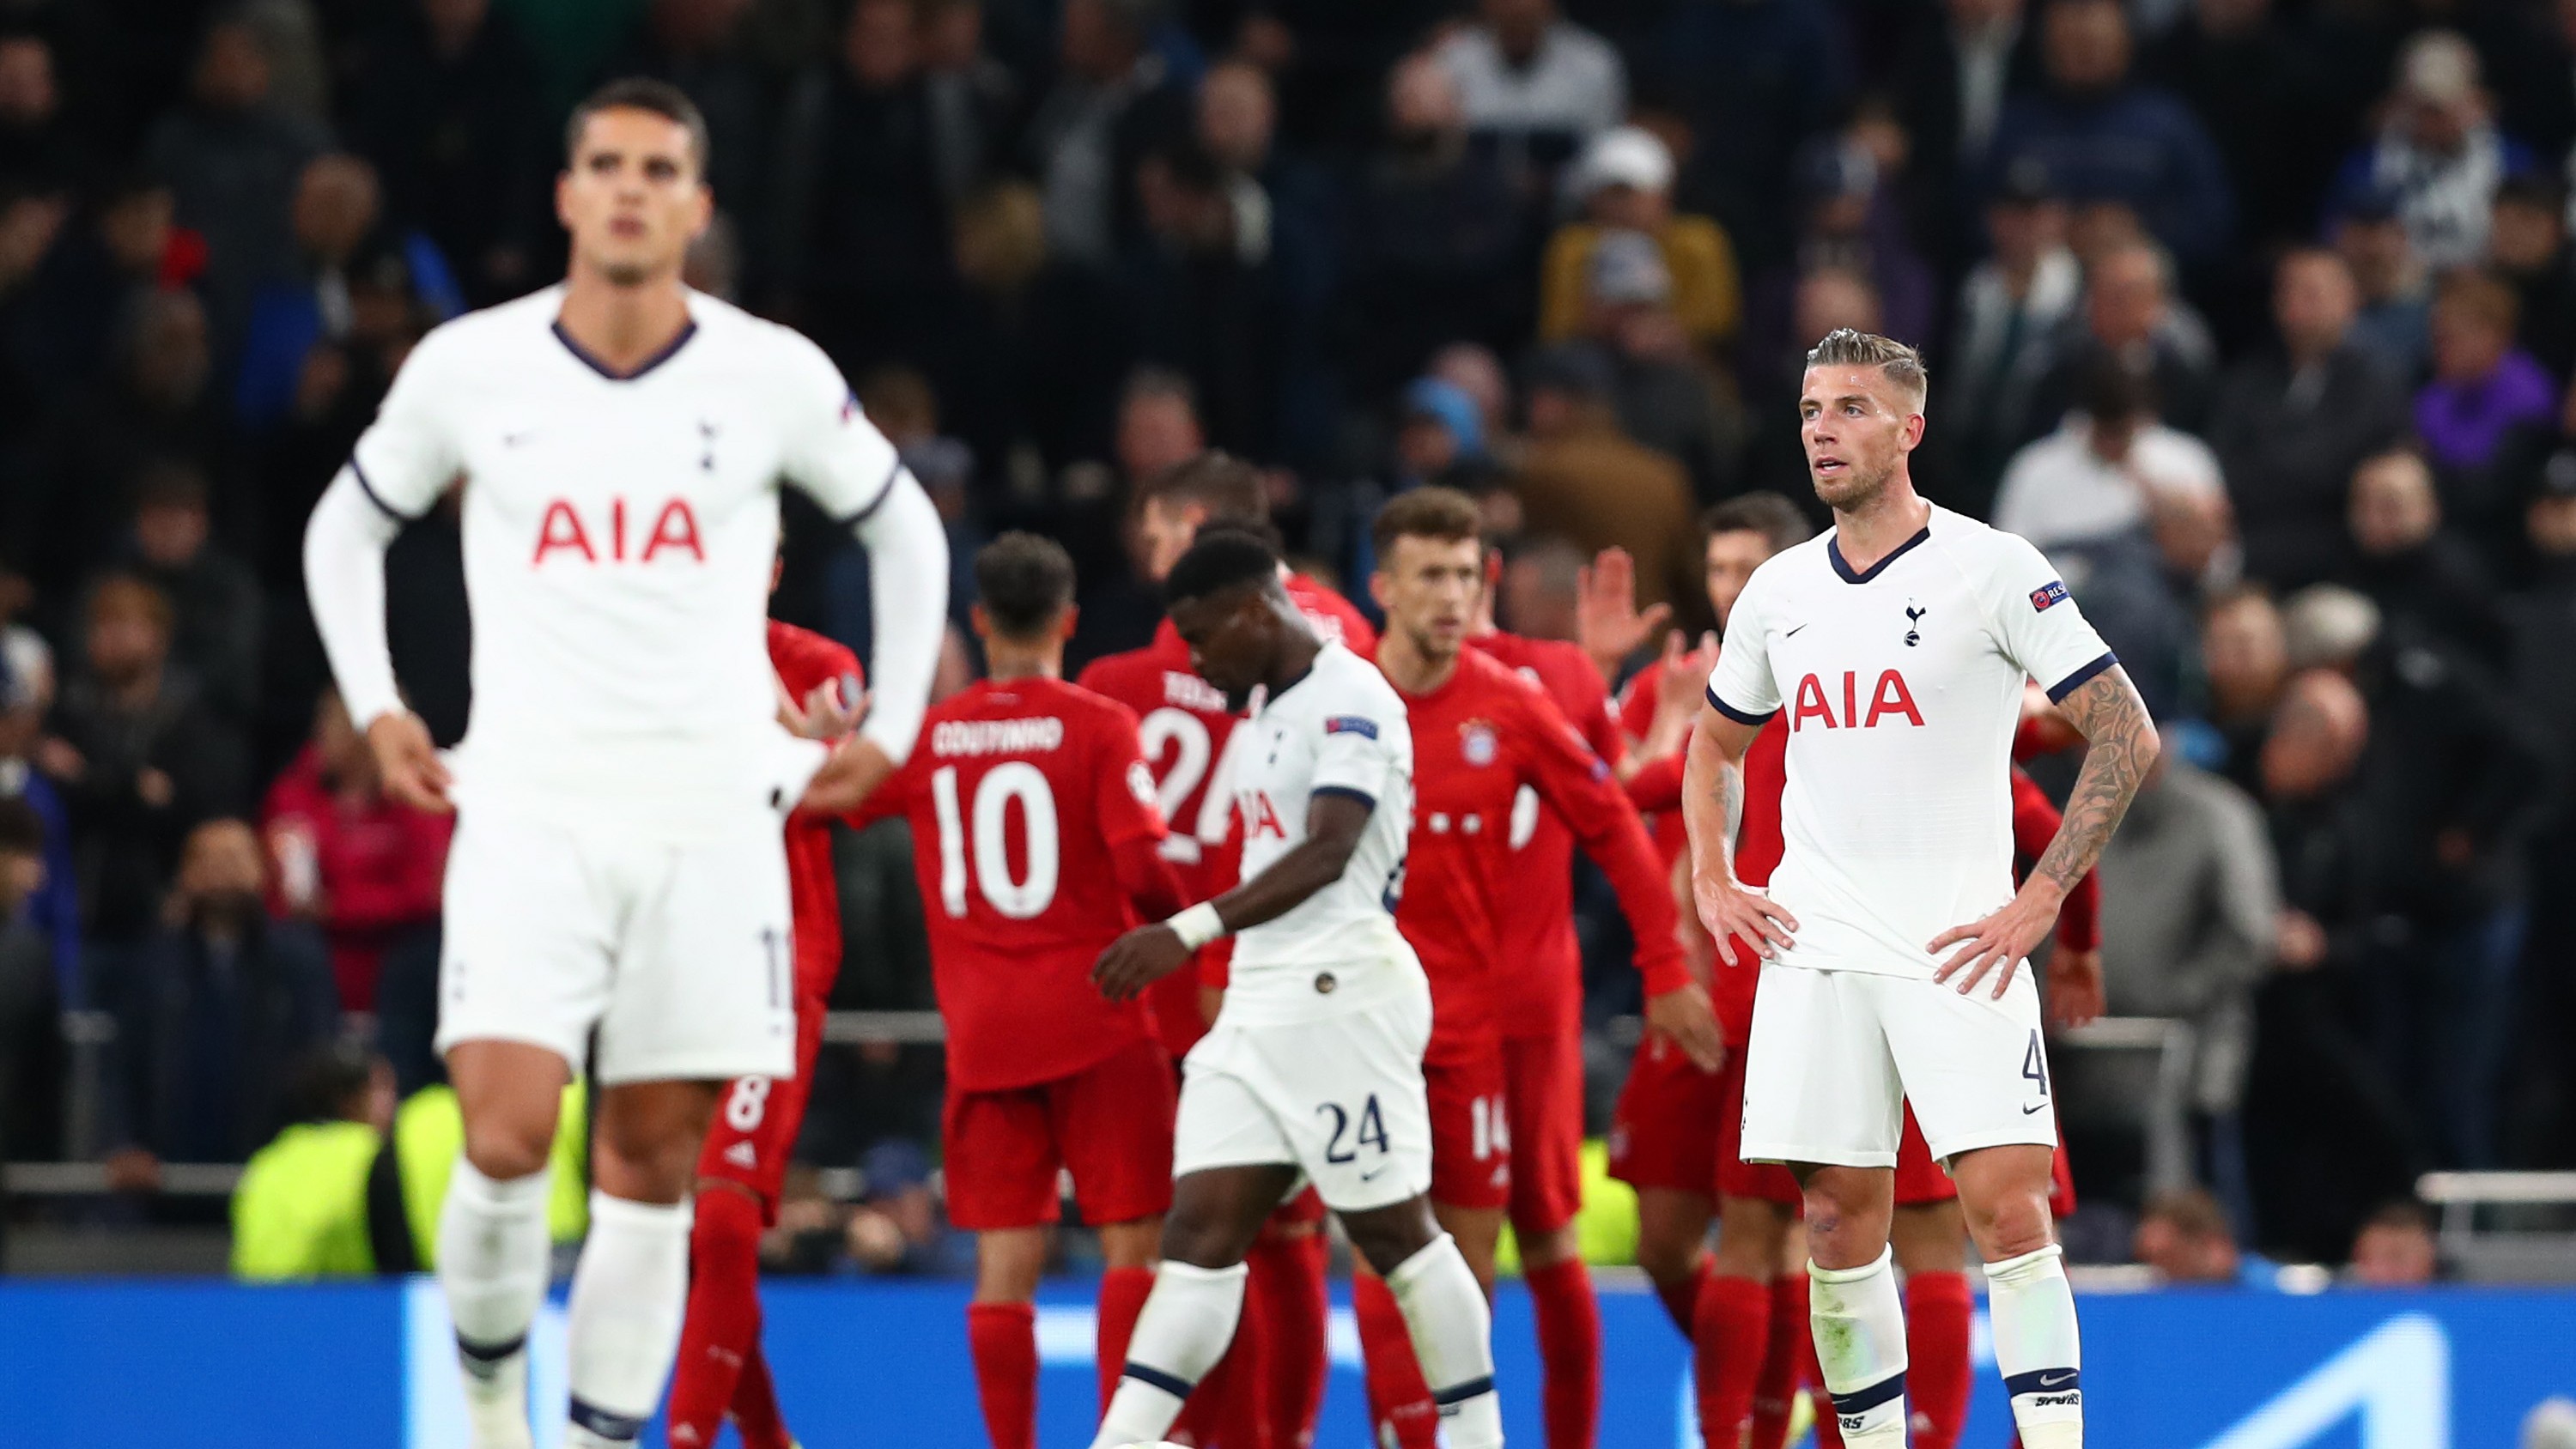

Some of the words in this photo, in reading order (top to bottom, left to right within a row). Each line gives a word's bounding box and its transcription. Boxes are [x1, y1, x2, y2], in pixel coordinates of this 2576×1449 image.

[531, 495, 706, 568] AIA
[1793, 669, 1925, 732] AIA
[932, 761, 1060, 919] 10
[2022, 1028, 2047, 1096] 4
[726, 1073, 772, 1132] 8
[1316, 1092, 1389, 1163] 24
